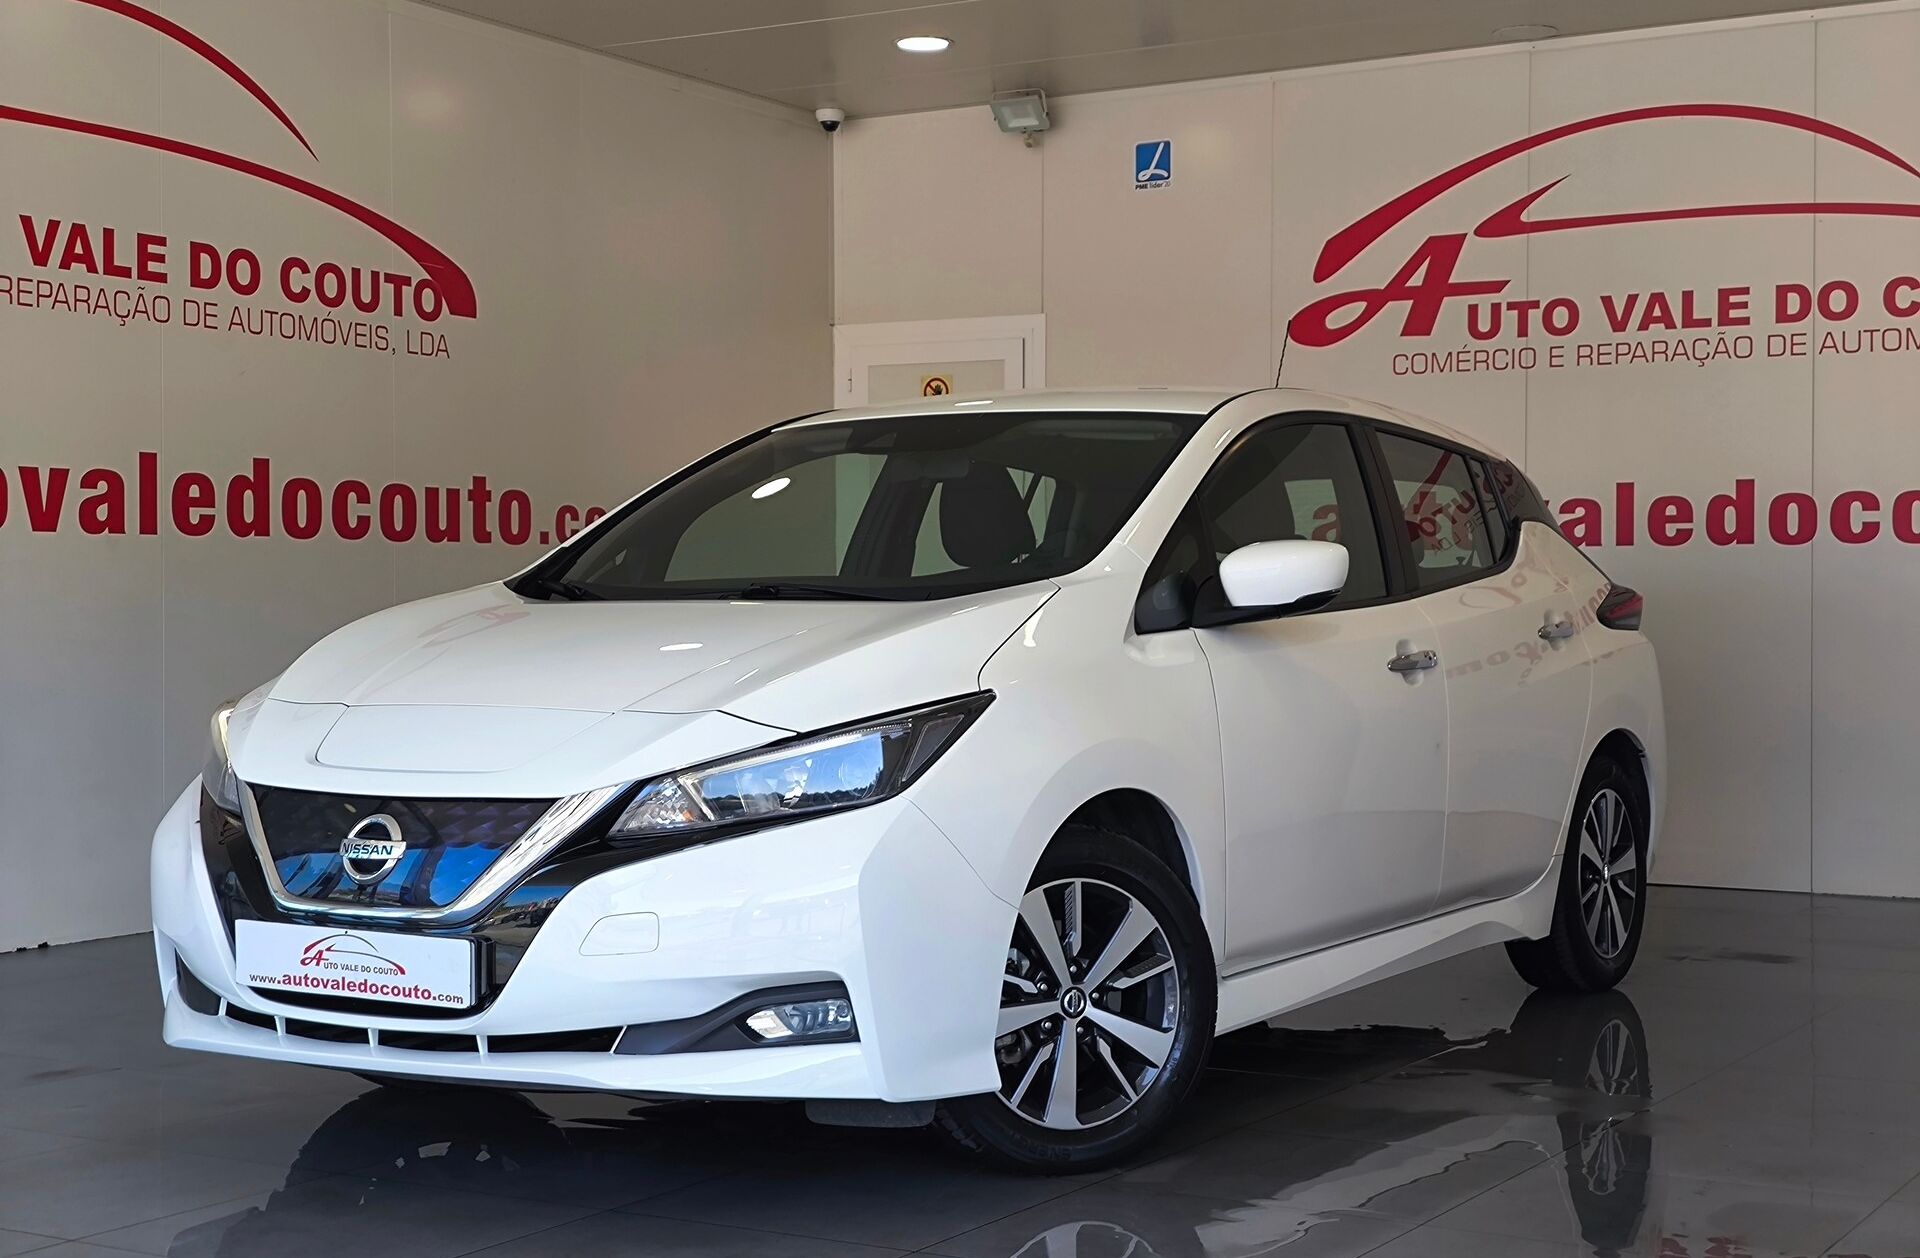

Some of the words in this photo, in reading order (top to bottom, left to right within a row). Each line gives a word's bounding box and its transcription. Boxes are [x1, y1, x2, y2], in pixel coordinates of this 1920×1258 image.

[19, 214, 168, 284] VALE
[190, 241, 261, 296] DO
[280, 256, 443, 322] COUTO
[0, 275, 171, 326] REPARAÇÃO
[183, 299, 218, 330] DE
[228, 306, 396, 355] AUTOMÓVEIS,
[406, 329, 450, 359] LDA
[1600, 287, 1750, 333] VALE
[1775, 280, 1859, 322] DO
[1393, 344, 1537, 376] COMÉRCIO
[1549, 346, 1565, 368] E
[1577, 331, 1753, 367] REPARAÇÃO
[1767, 333, 1807, 357] DE
[0, 451, 608, 545] valedocouto.c
[1545, 479, 1920, 547] aledoco
[341, 842, 394, 856] NISSAN
[250, 972, 464, 1005] www.autovaledocouto.com
[340, 963, 358, 972] VALE
[360, 965, 372, 973] DO
[373, 967, 398, 976] COUTO
